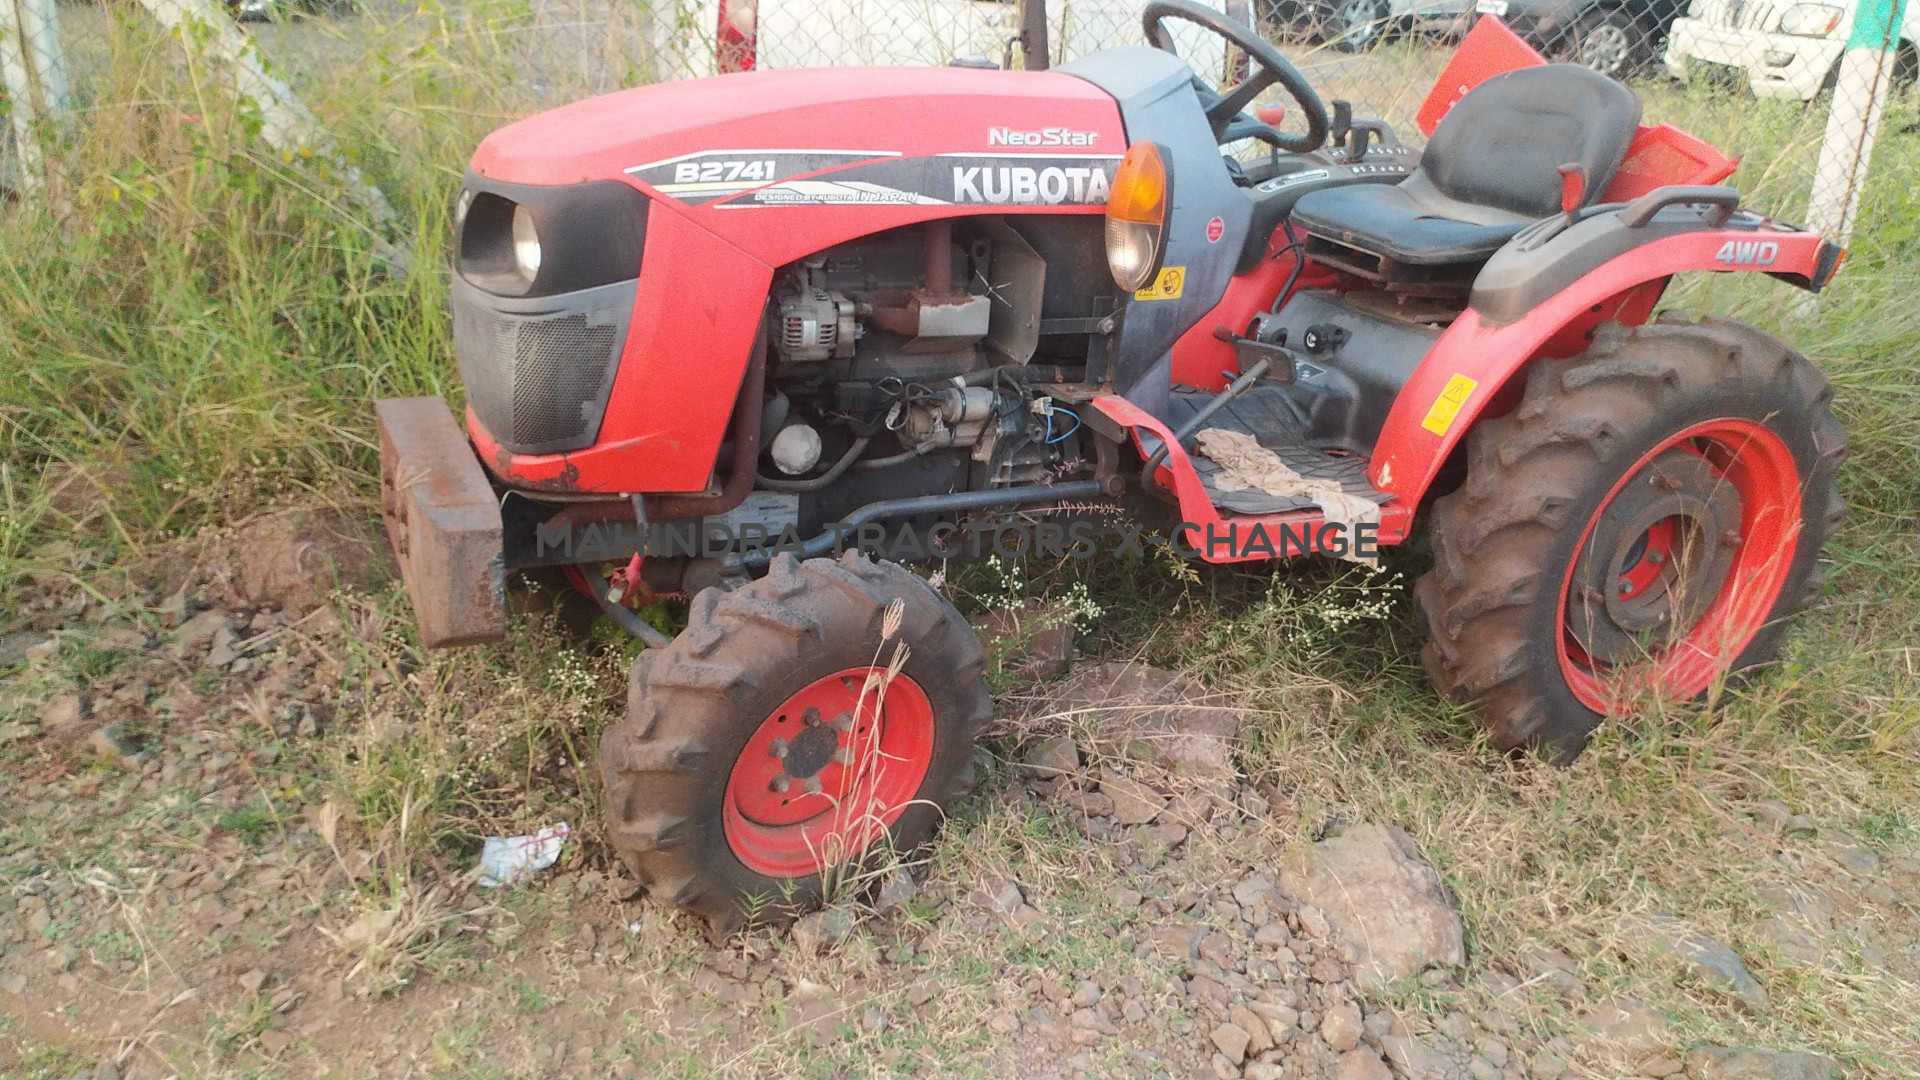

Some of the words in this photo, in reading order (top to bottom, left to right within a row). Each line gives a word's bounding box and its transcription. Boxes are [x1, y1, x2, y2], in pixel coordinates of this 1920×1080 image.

[988, 127, 1098, 146] NeoStar
[674, 160, 776, 183] B2741
[871, 191, 919, 203] JAPAN
[953, 167, 1111, 204] KUBOTA
[1715, 240, 1779, 266] 4WD
